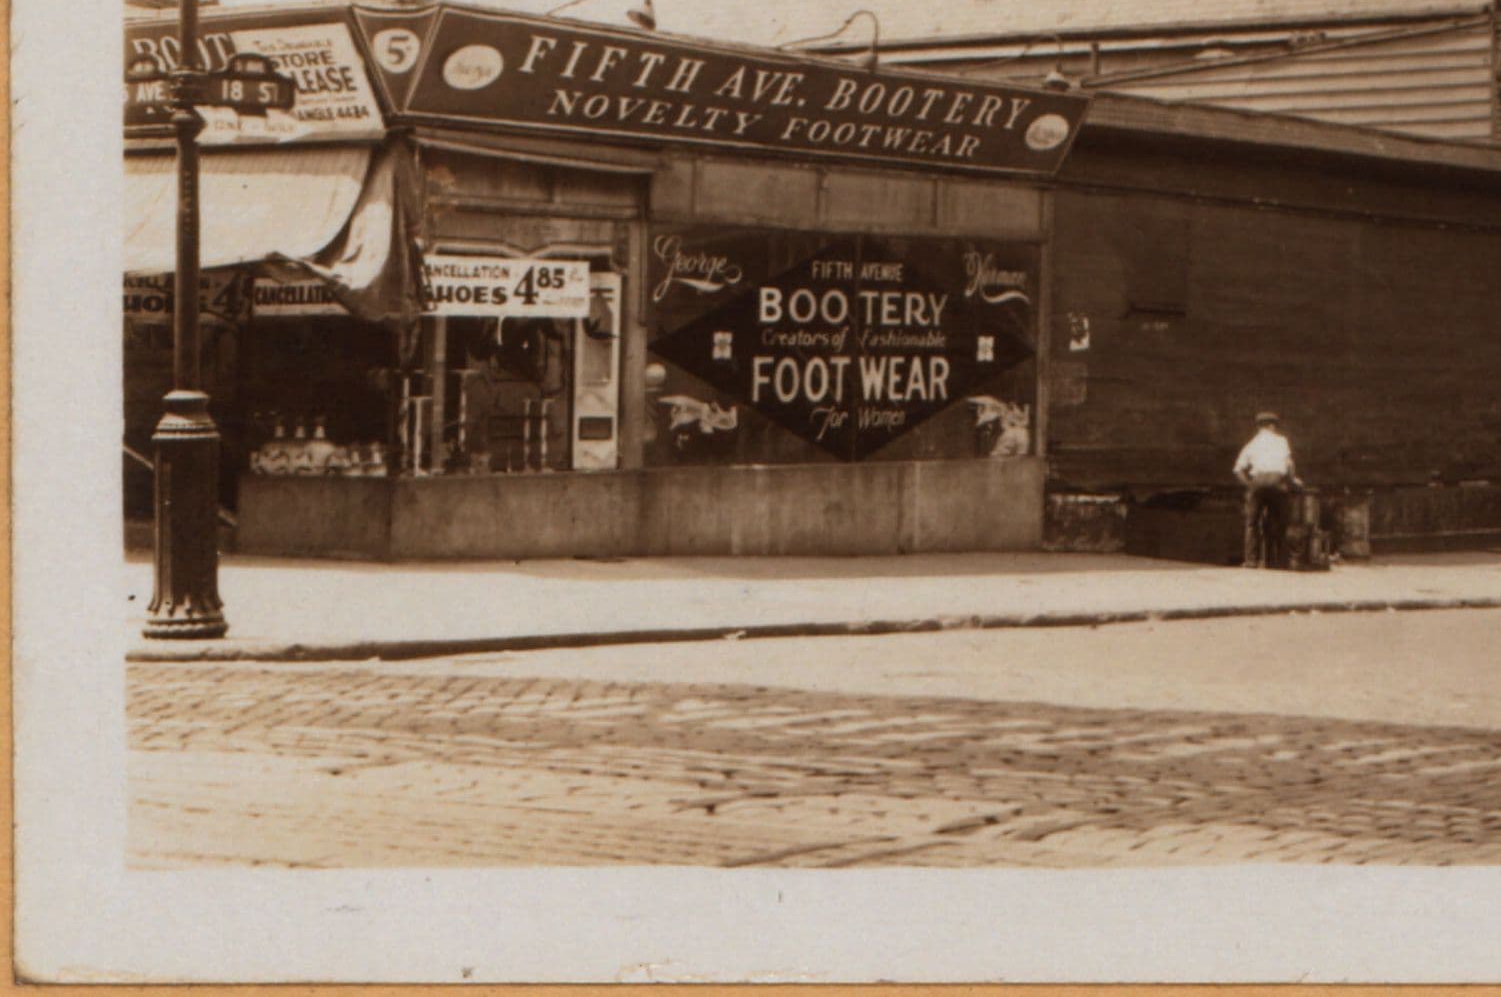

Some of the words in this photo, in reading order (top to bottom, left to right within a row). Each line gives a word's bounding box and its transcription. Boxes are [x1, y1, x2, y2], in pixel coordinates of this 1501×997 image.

[273, 50, 337, 68] STORE
[388, 35, 409, 65] 5
[222, 79, 243, 101] 18
[258, 81, 278, 103] ST
[292, 67, 357, 94] LEASE
[517, 35, 705, 92] FIFTH
[714, 65, 806, 107] AVE.
[825, 79, 1030, 129] BOOTERY
[547, 90, 762, 135] NOVELTY
[781, 117, 981, 158] FOOTWEAR
[423, 264, 510, 280] ANCELLATION
[653, 235, 742, 302] George
[812, 260, 854, 280] FIFTH
[860, 262, 904, 282] AVENUE
[254, 285, 338, 304] CANCELLATIO
[761, 328, 829, 346] Creators
[831, 326, 850, 352] of
